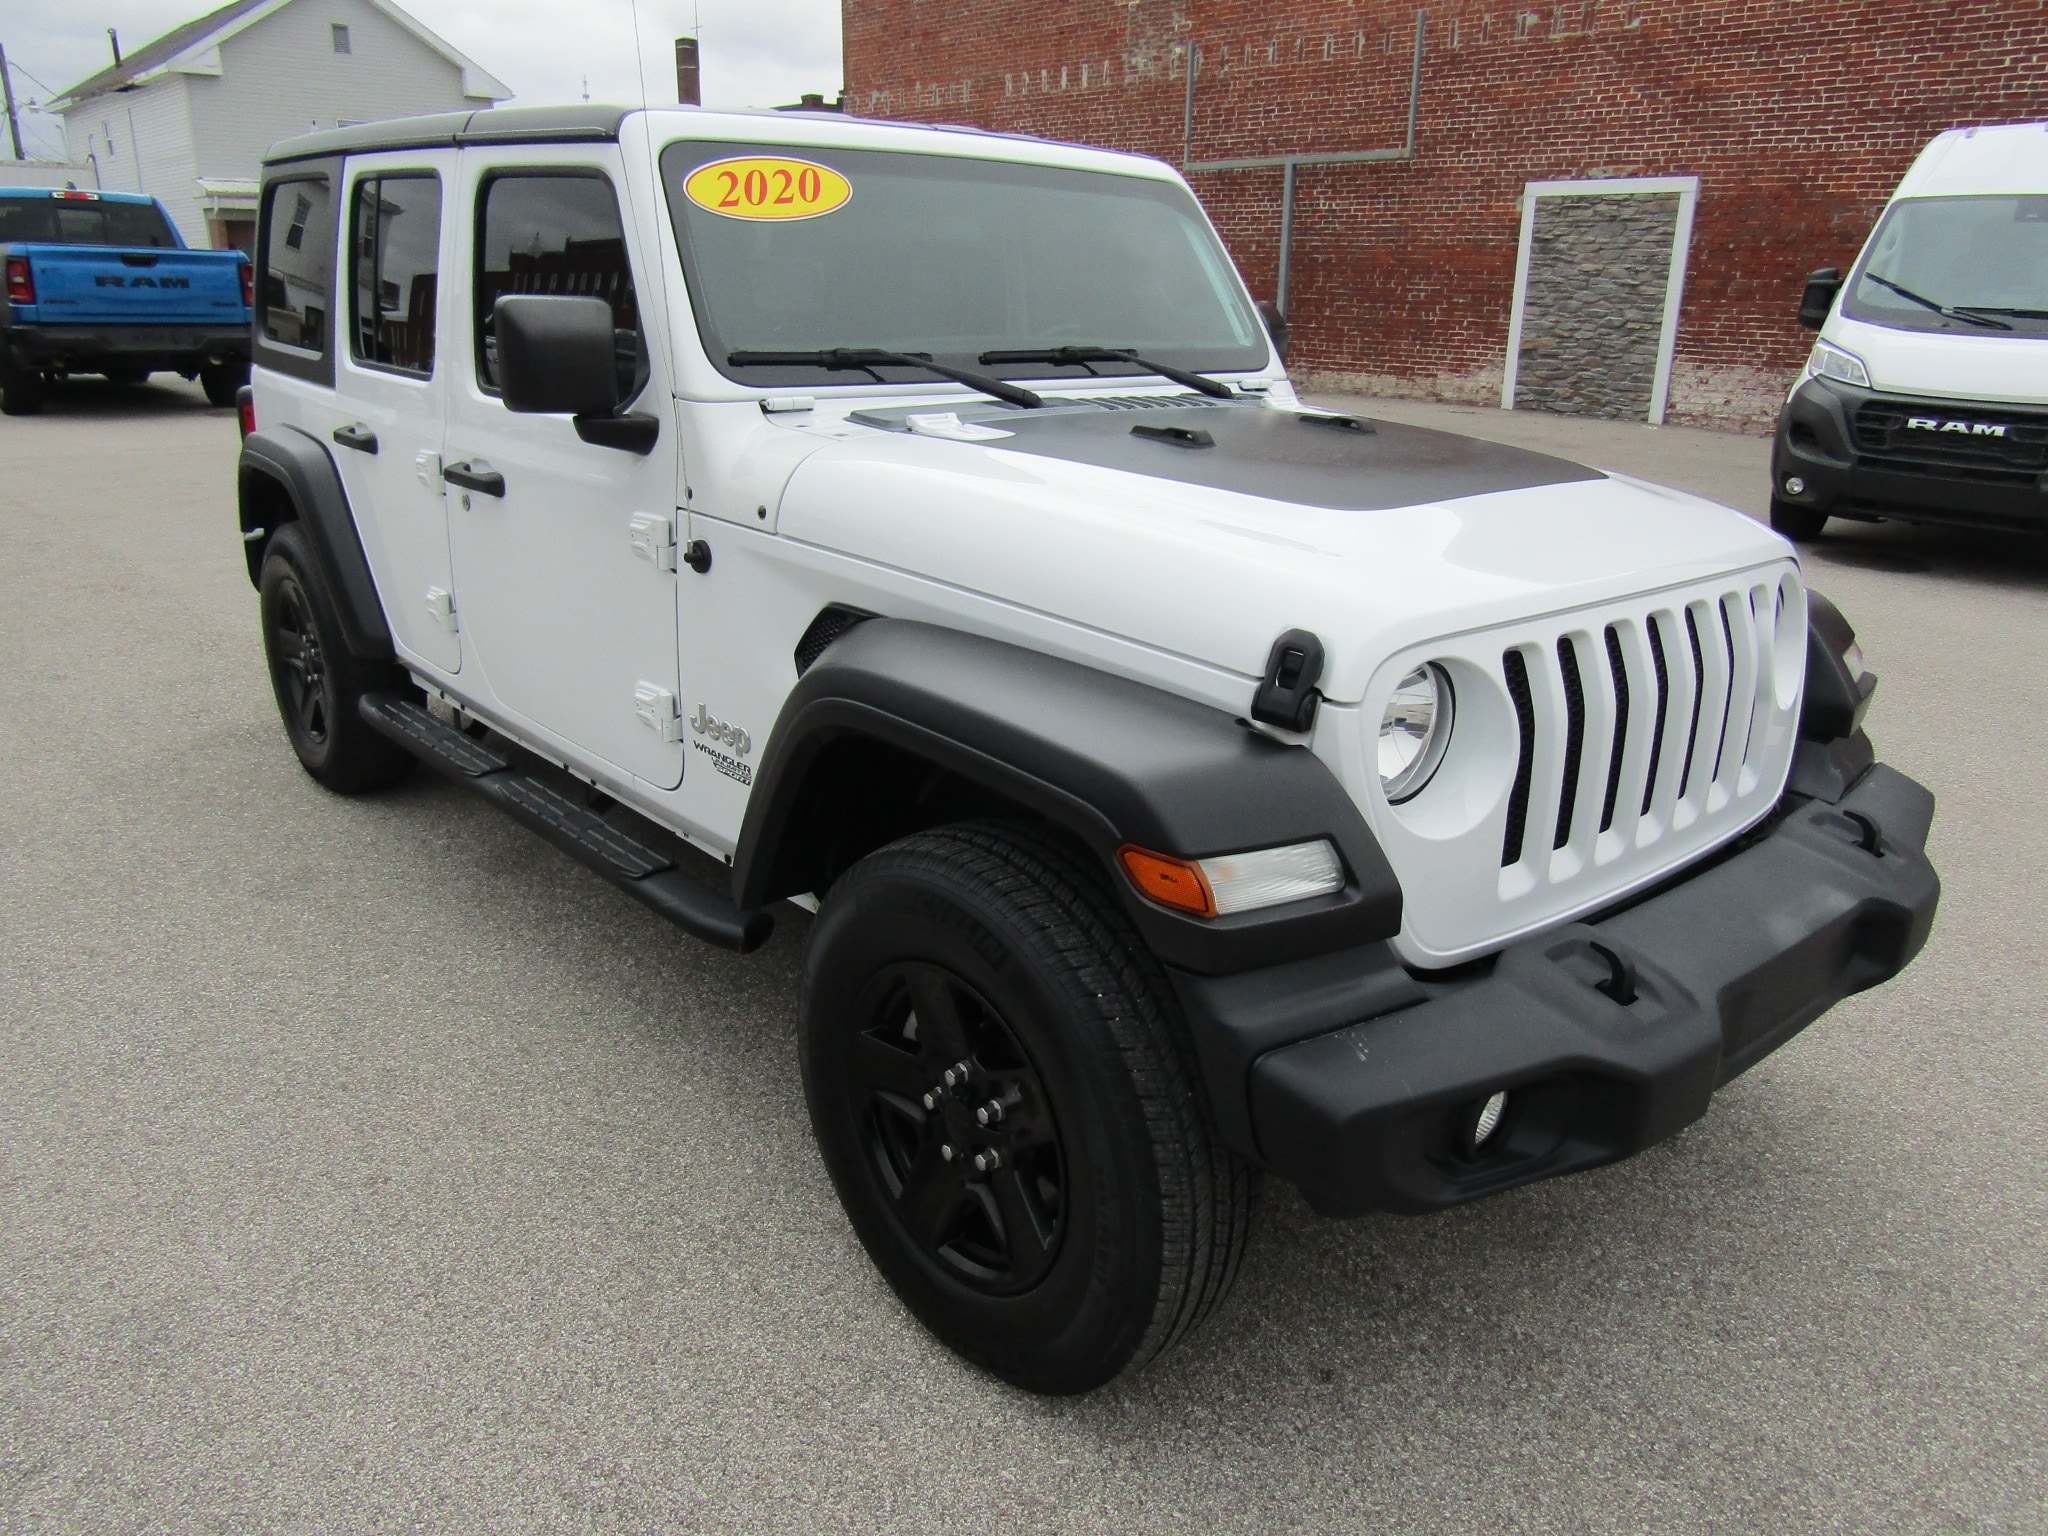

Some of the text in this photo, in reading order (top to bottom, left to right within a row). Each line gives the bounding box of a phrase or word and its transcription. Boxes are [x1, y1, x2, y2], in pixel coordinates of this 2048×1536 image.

[717, 168, 821, 207] 2020
[94, 275, 190, 289] RAM
[1907, 418, 2006, 437] RAM
[690, 702, 751, 758] Jeep
[693, 740, 751, 774] WRANGLER
